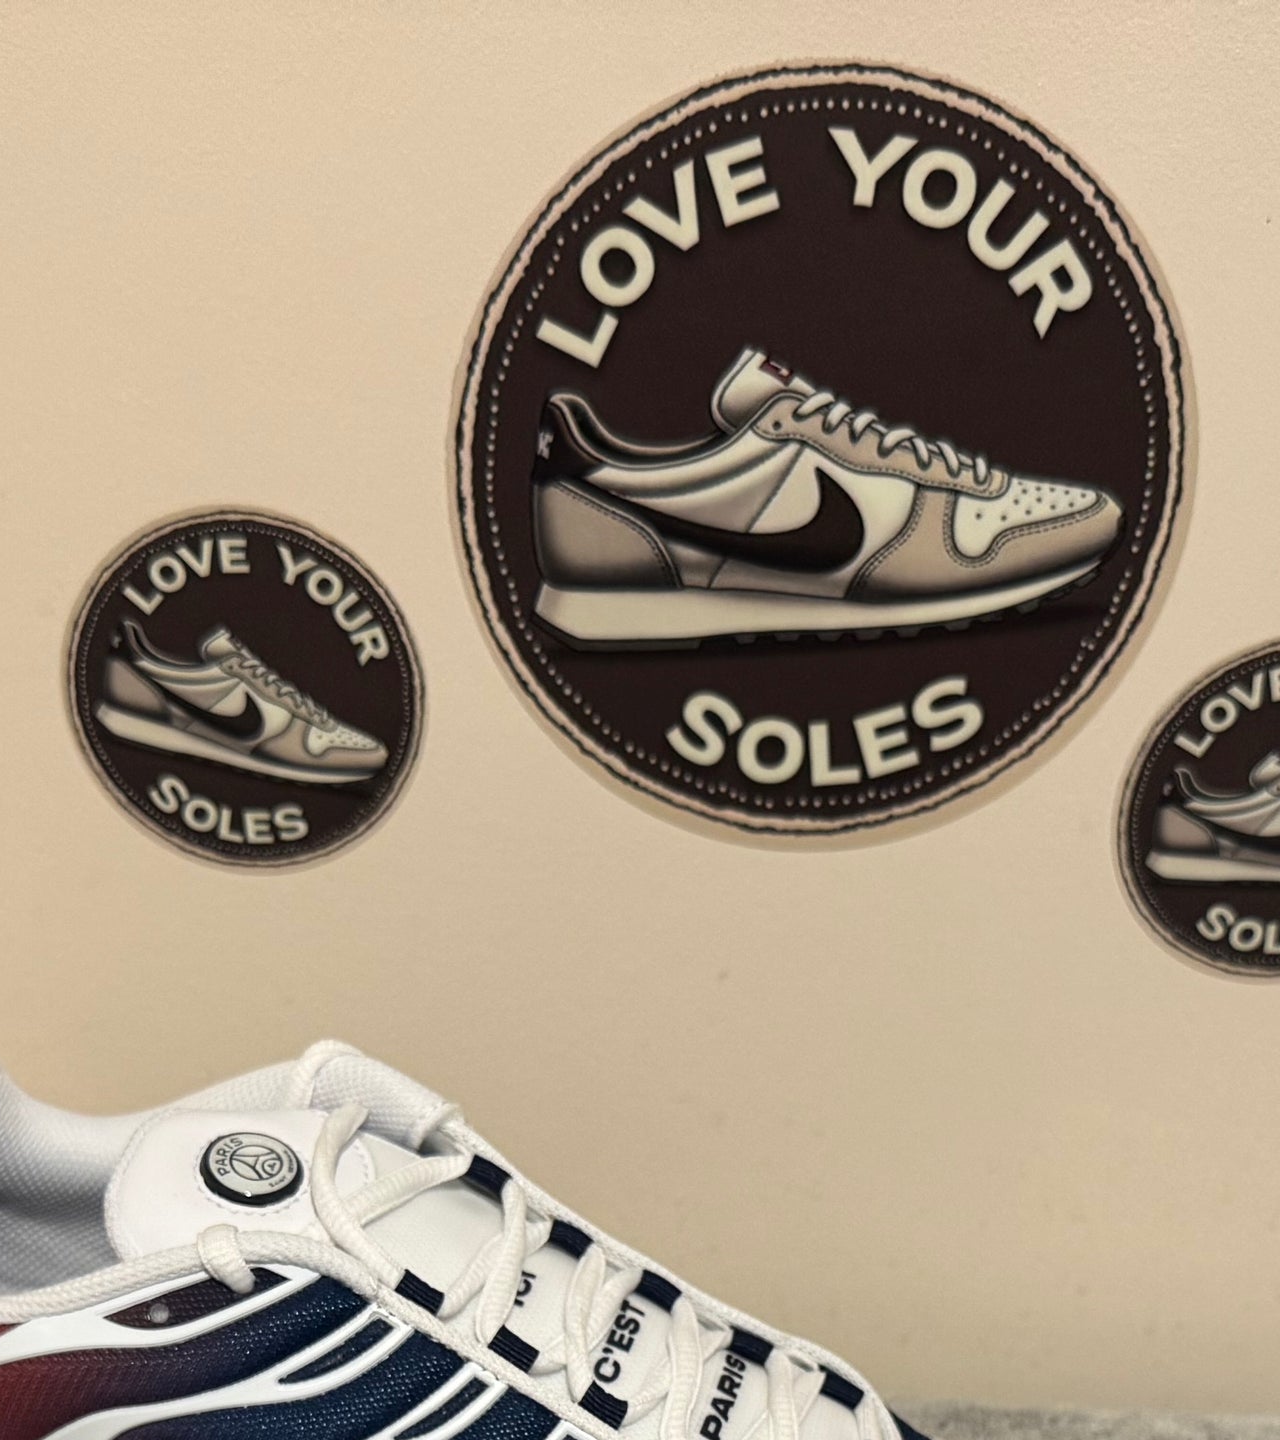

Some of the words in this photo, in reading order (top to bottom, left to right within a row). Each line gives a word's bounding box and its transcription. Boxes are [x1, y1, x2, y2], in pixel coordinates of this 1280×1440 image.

[536, 136, 780, 368] LOVE
[827, 126, 1094, 339] YOUR
[123, 538, 251, 616] LOVE
[276, 544, 390, 667] YOUR
[666, 676, 984, 787] SOLES
[149, 775, 309, 845] SOLES
[215, 1137, 244, 1178] PARIS
[593, 1299, 646, 1384] C'EST
